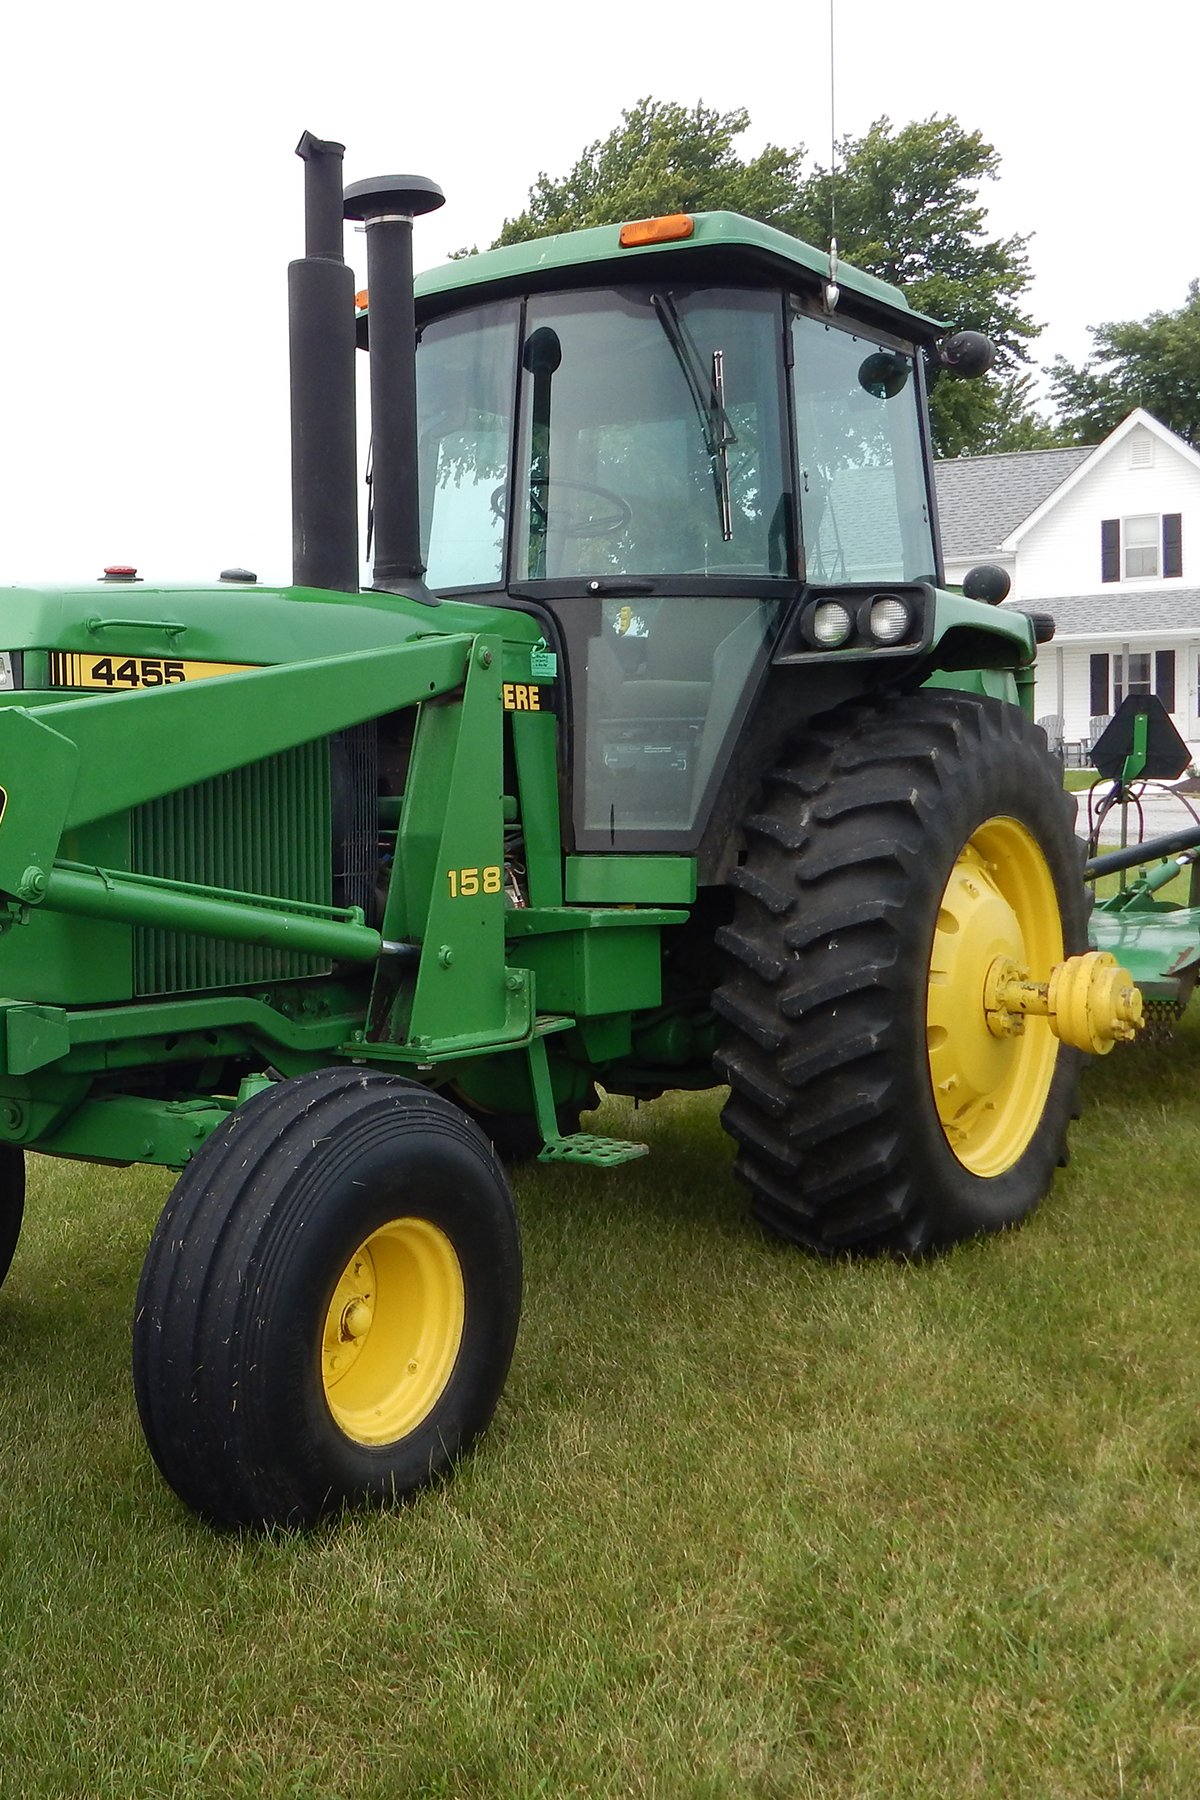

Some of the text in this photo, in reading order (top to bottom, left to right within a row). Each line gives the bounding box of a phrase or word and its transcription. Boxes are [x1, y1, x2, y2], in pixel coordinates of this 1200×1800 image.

[92, 658, 186, 687] 4455
[503, 684, 541, 710] ERE
[447, 866, 501, 898] 158
